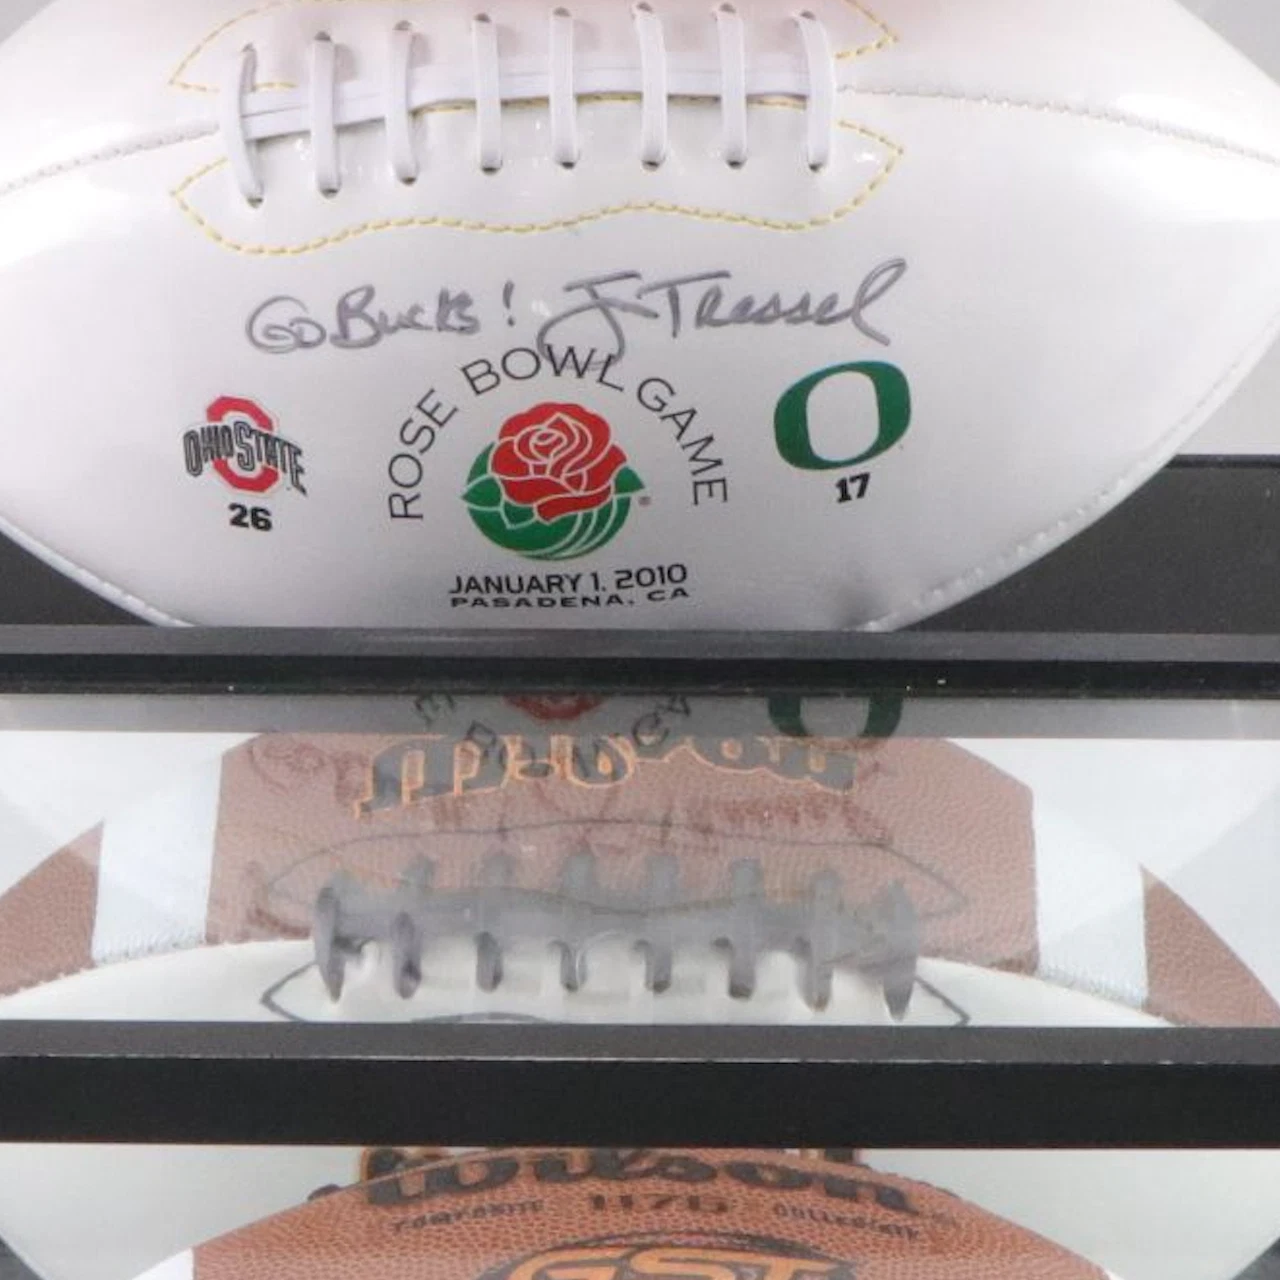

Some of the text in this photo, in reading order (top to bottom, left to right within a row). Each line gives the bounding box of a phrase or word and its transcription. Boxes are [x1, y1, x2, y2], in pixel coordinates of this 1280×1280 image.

[388, 344, 729, 520] ROSE BOWL GAME
[834, 471, 872, 504] 17
[228, 502, 274, 533] 26
[448, 572, 583, 596] JANUARY
[613, 562, 689, 590] 2010
[646, 586, 690, 603] CA
